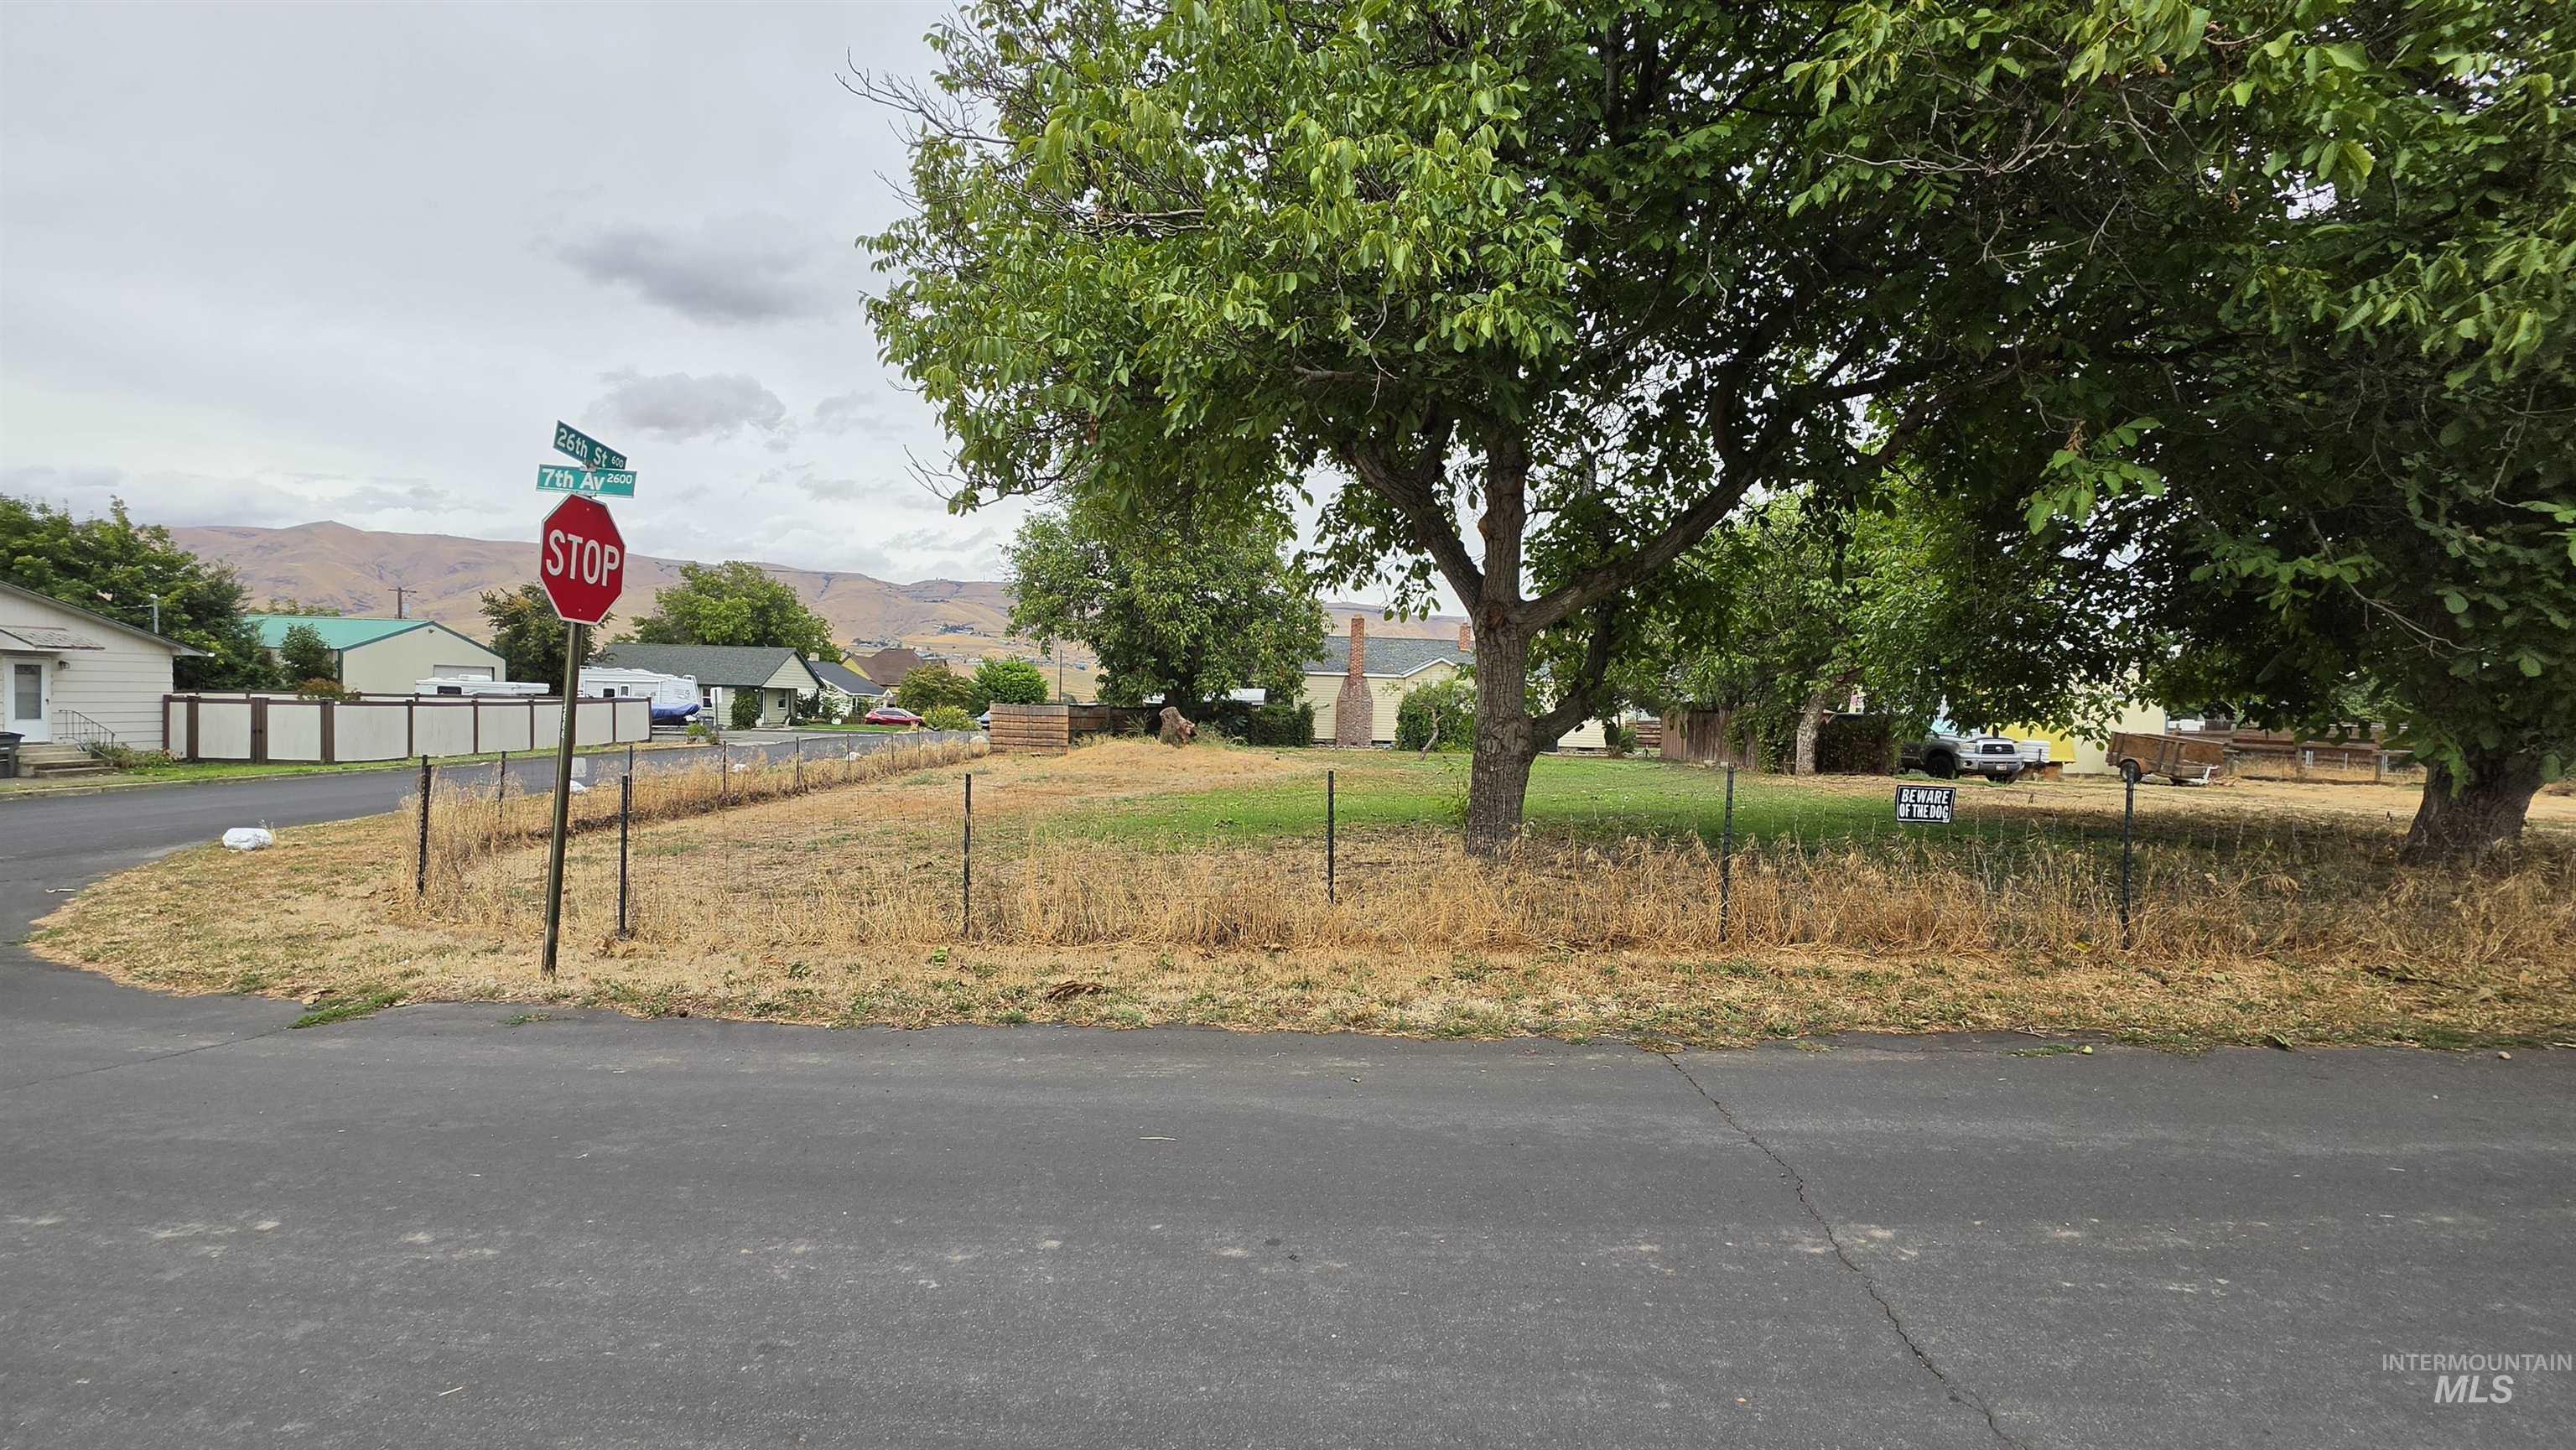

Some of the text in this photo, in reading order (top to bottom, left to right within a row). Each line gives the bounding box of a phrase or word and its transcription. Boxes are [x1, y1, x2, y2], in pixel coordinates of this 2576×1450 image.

[556, 429, 626, 468] 26th St 600
[542, 468, 633, 491] 7th Av 2600
[546, 529, 620, 587] STOP
[1901, 788, 1950, 804] BEWARE
[1898, 803, 1949, 819] OF THE DOG
